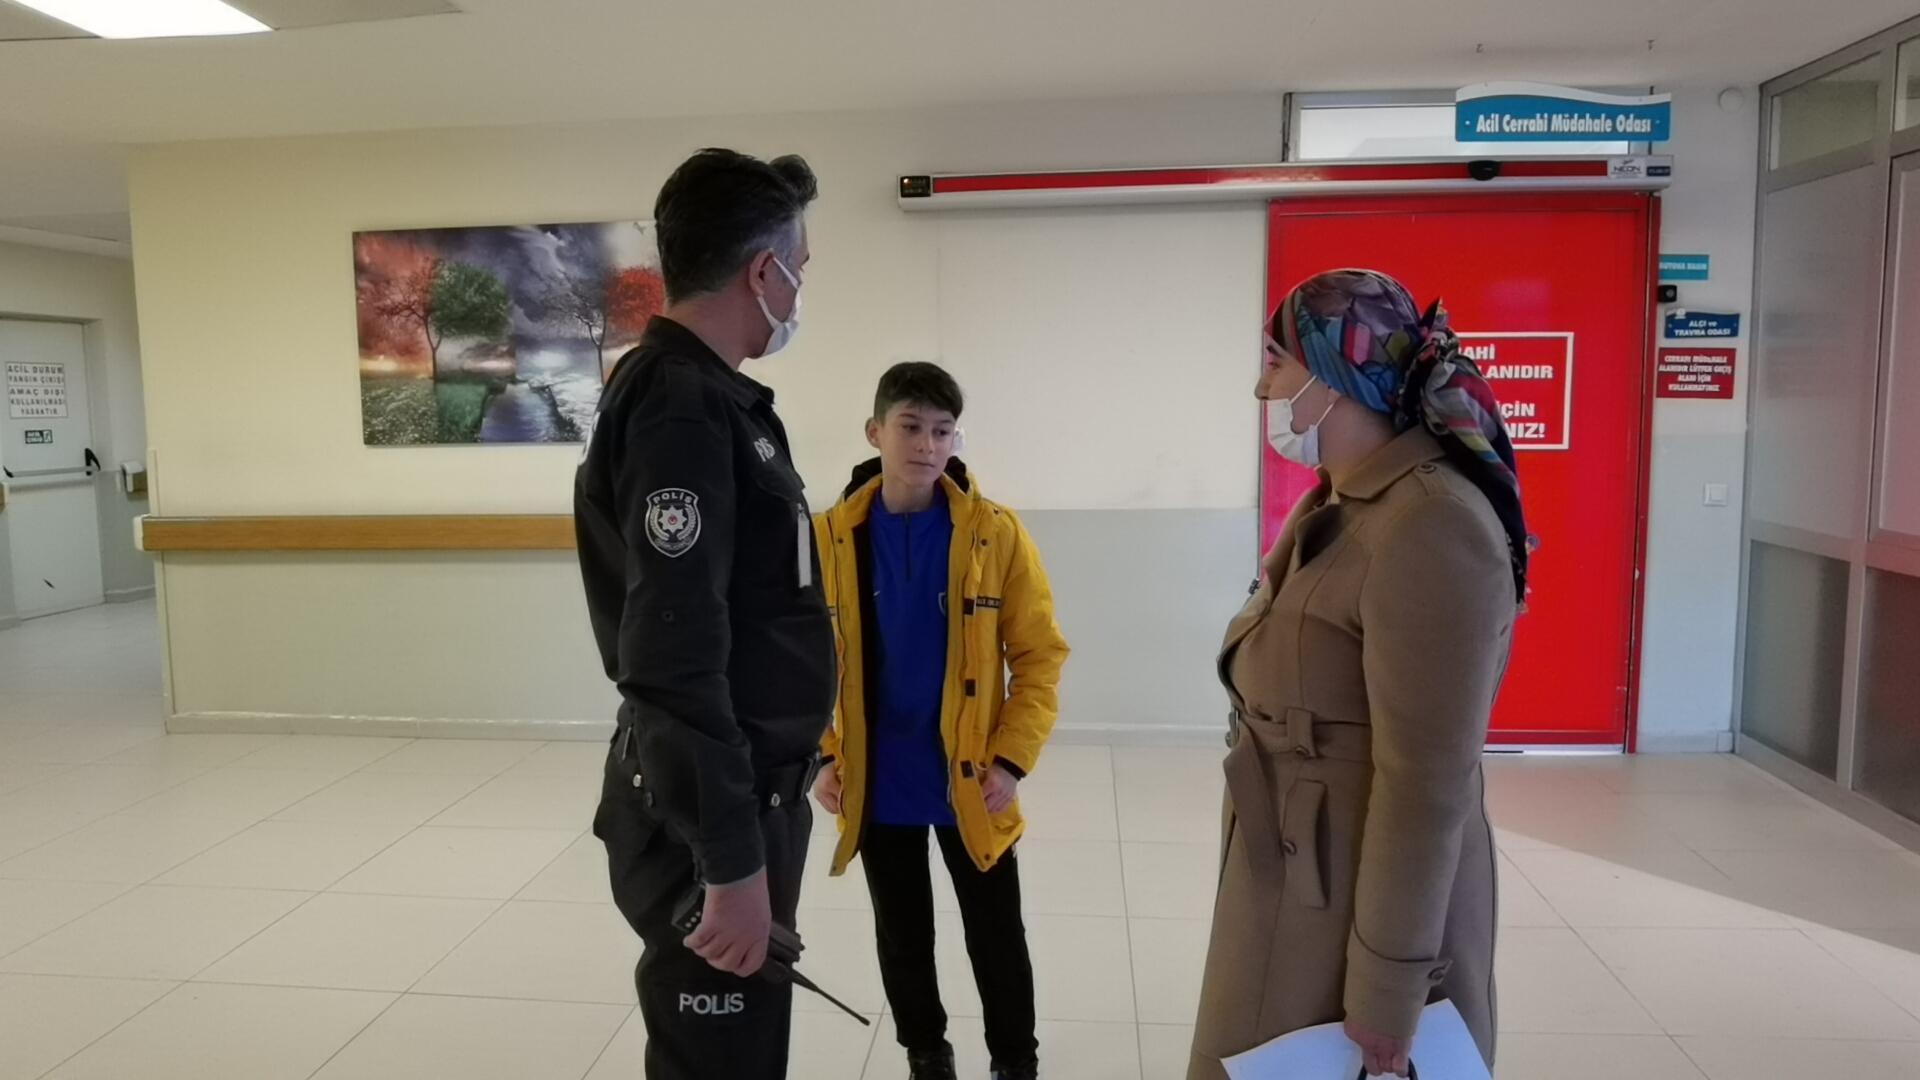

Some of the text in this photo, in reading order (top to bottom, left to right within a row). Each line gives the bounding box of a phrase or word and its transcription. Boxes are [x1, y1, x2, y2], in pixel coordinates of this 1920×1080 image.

[1476, 112, 1651, 133] Acil Cerrahi Müdahale Odası
